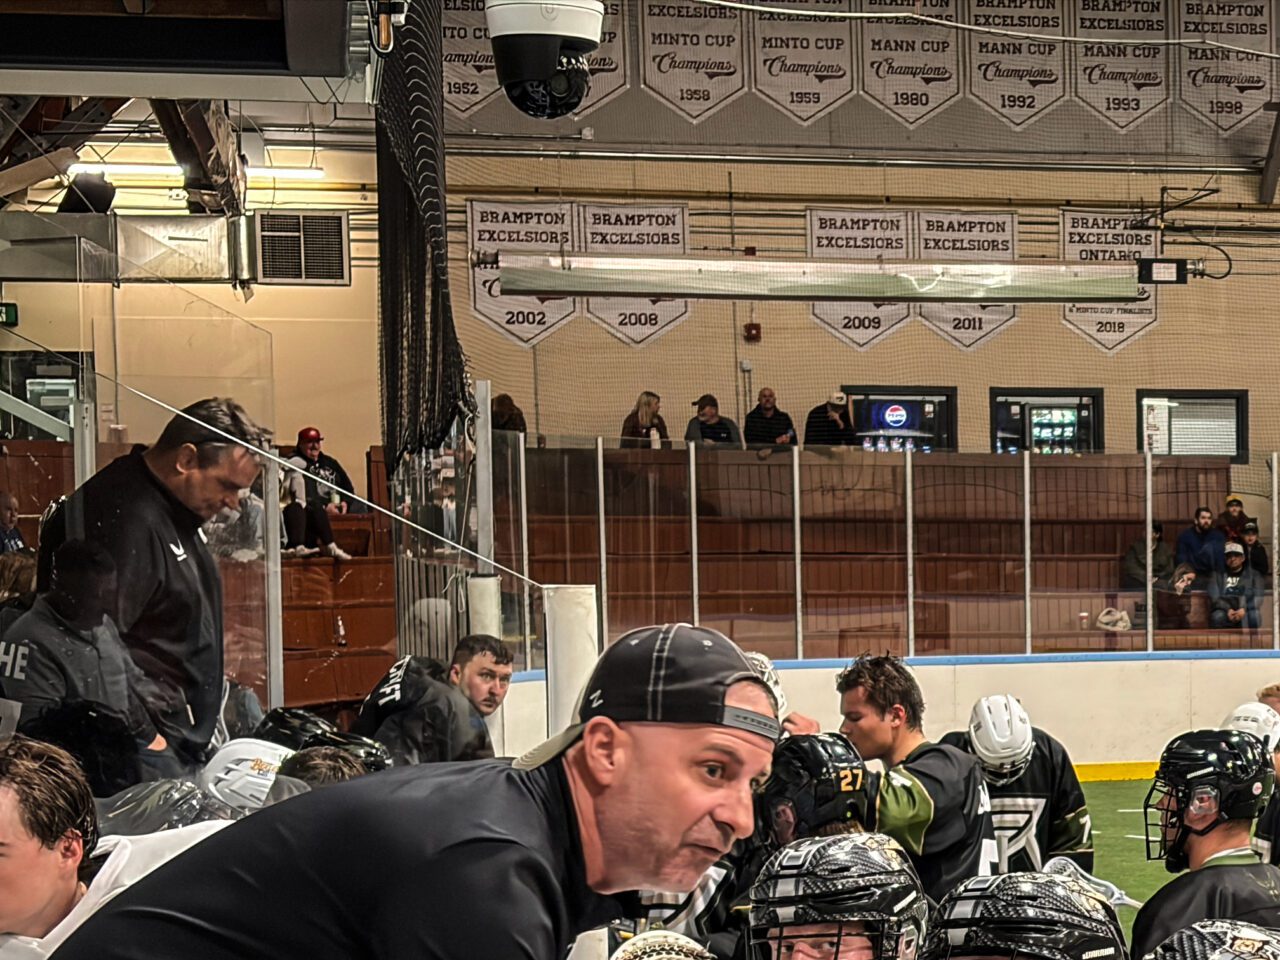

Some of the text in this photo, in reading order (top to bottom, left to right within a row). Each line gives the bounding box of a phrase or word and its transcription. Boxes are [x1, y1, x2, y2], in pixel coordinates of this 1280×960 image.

[648, 5, 738, 19] EXCELSIORS
[1186, 4, 1265, 17] BRAMPTON
[974, 14, 1060, 28] EXCELSIORS
[1079, 18, 1165, 31] EXCELSIORS
[1184, 21, 1268, 35] EXCELSIORS
[651, 33, 735, 47] MINTO CUP
[762, 37, 844, 50] MINTO CUP
[871, 39, 950, 53] MANN CUP
[978, 42, 1056, 56] MANN CUP
[1083, 45, 1161, 59] MANN CUP
[1188, 49, 1230, 61] MANN
[652, 52, 737, 79] Champions
[763, 56, 846, 82] Champions
[870, 58, 952, 85] Champions
[977, 61, 1058, 88] Champions
[1083, 64, 1162, 90] Champions
[1187, 67, 1266, 93] Champions
[447, 82, 479, 95] 1952
[679, 89, 710, 101] 1958
[789, 91, 820, 104] 1959
[893, 92, 929, 106] 1980
[1000, 94, 1035, 109] 1992
[1105, 97, 1140, 111] 1993
[1209, 101, 1243, 114] 1998
[479, 211, 565, 225] BRAMPTON
[592, 213, 677, 226] BRAMPTON
[819, 217, 900, 231] BRAMPTON
[926, 220, 1006, 233] BRAMPTON
[477, 230, 569, 243] EXCELSIORS
[590, 232, 680, 245] EXCELSIORS
[816, 237, 904, 250] EXCELSIORS
[1068, 232, 1153, 246] EXCELSIORS
[923, 238, 1010, 251] EXCELSIORS
[505, 311, 547, 326] 2002
[618, 313, 659, 326] 2008
[842, 316, 881, 330] 2009
[952, 318, 983, 331] 2011
[1096, 321, 1125, 333] 2018
[840, 770, 863, 792] 27
